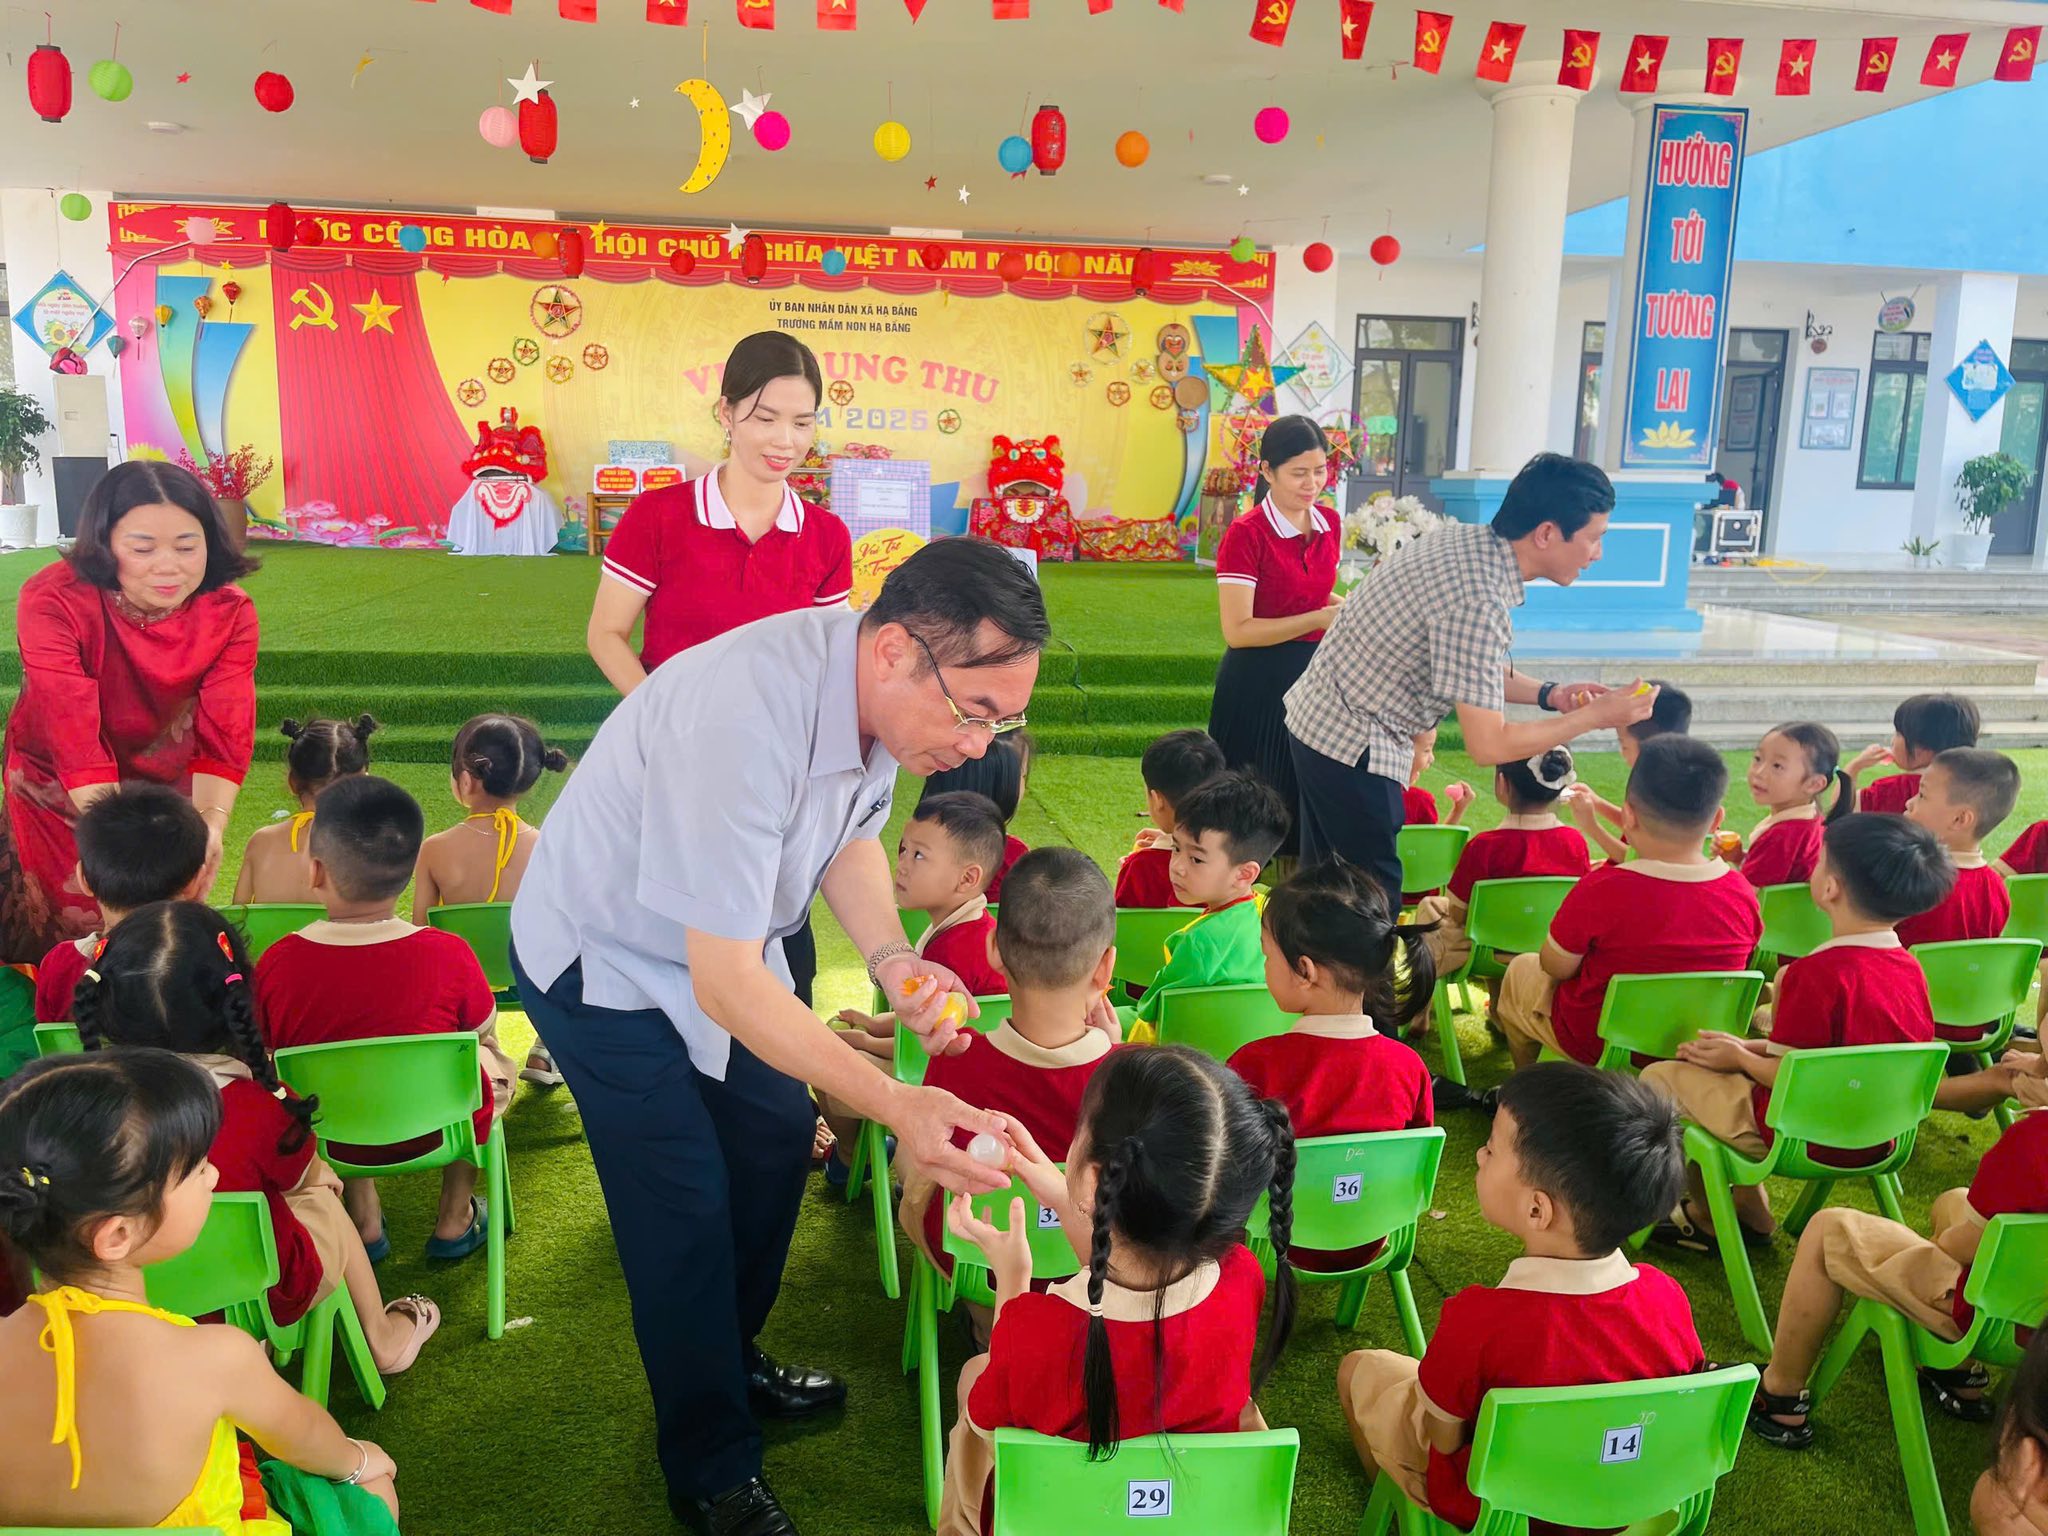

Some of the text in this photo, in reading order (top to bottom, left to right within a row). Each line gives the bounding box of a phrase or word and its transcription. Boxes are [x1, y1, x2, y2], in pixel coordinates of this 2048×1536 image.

[1658, 131, 1732, 188] HƯỚNG
[465, 225, 532, 251] HÒA
[595, 233, 647, 259] HỘI
[907, 248, 977, 270] NM
[1671, 208, 1706, 263] TỚI
[785, 301, 805, 312] BAN
[808, 301, 835, 313] NHÂN
[838, 302, 858, 314] DÂN
[1646, 289, 1715, 339] TƯƠNG
[846, 321, 867, 332] NON
[920, 360, 1000, 404] THU
[1655, 368, 1690, 412] LAI
[846, 408, 929, 431] 2025
[1336, 1180, 1359, 1197] 36
[1608, 1434, 1637, 1456] 14
[1131, 1488, 1166, 1509] 29
